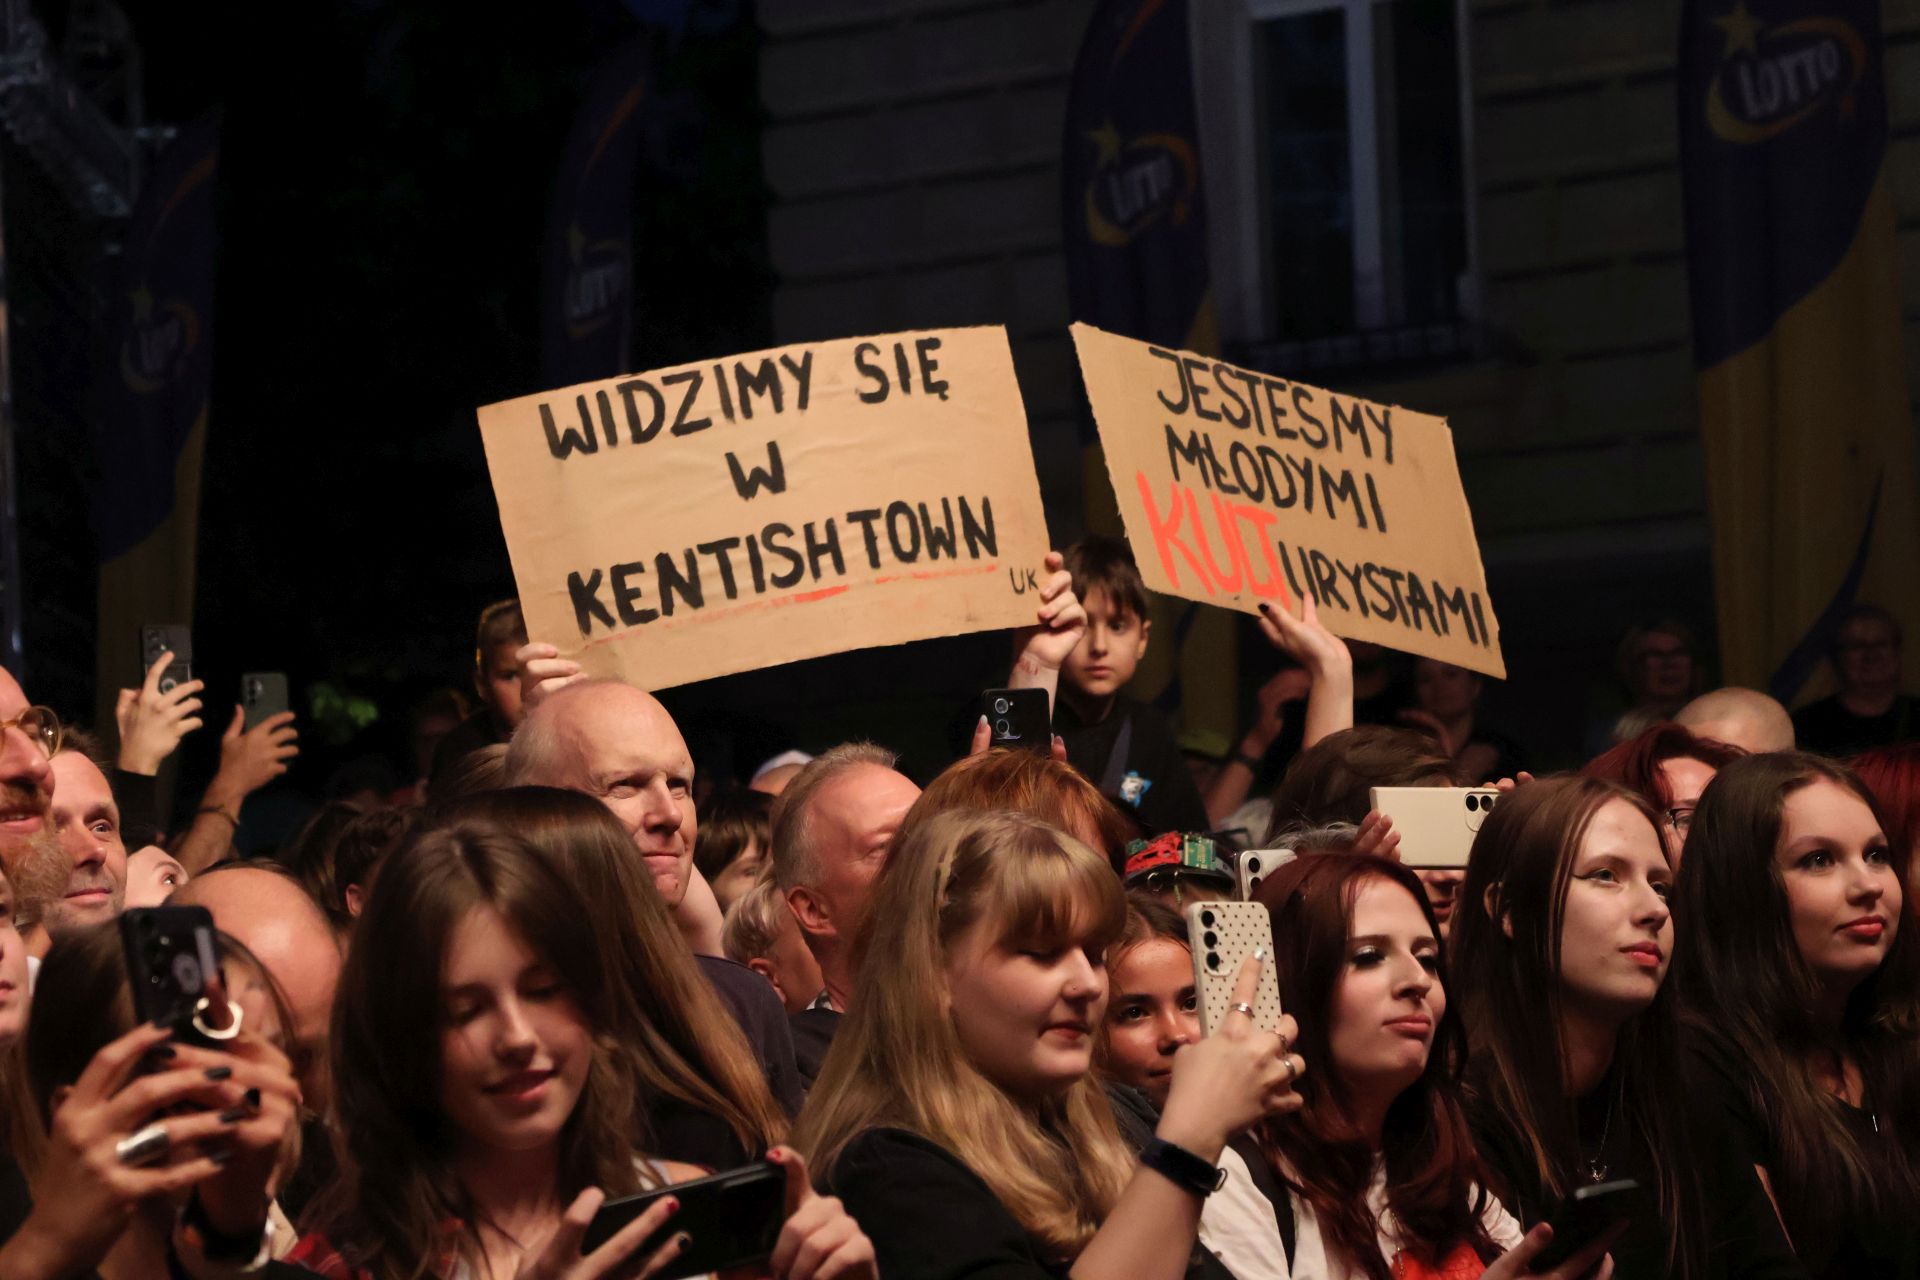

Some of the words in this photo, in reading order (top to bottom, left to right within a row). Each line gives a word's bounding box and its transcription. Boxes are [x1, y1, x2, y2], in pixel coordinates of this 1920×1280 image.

[1740, 40, 1839, 120] LOTTO
[539, 350, 813, 460] WIDZIMY
[854, 337, 950, 404] SIĘ
[724, 441, 787, 500] W
[1164, 424, 1387, 533] MŁODYMI
[1010, 567, 1039, 595] UK
